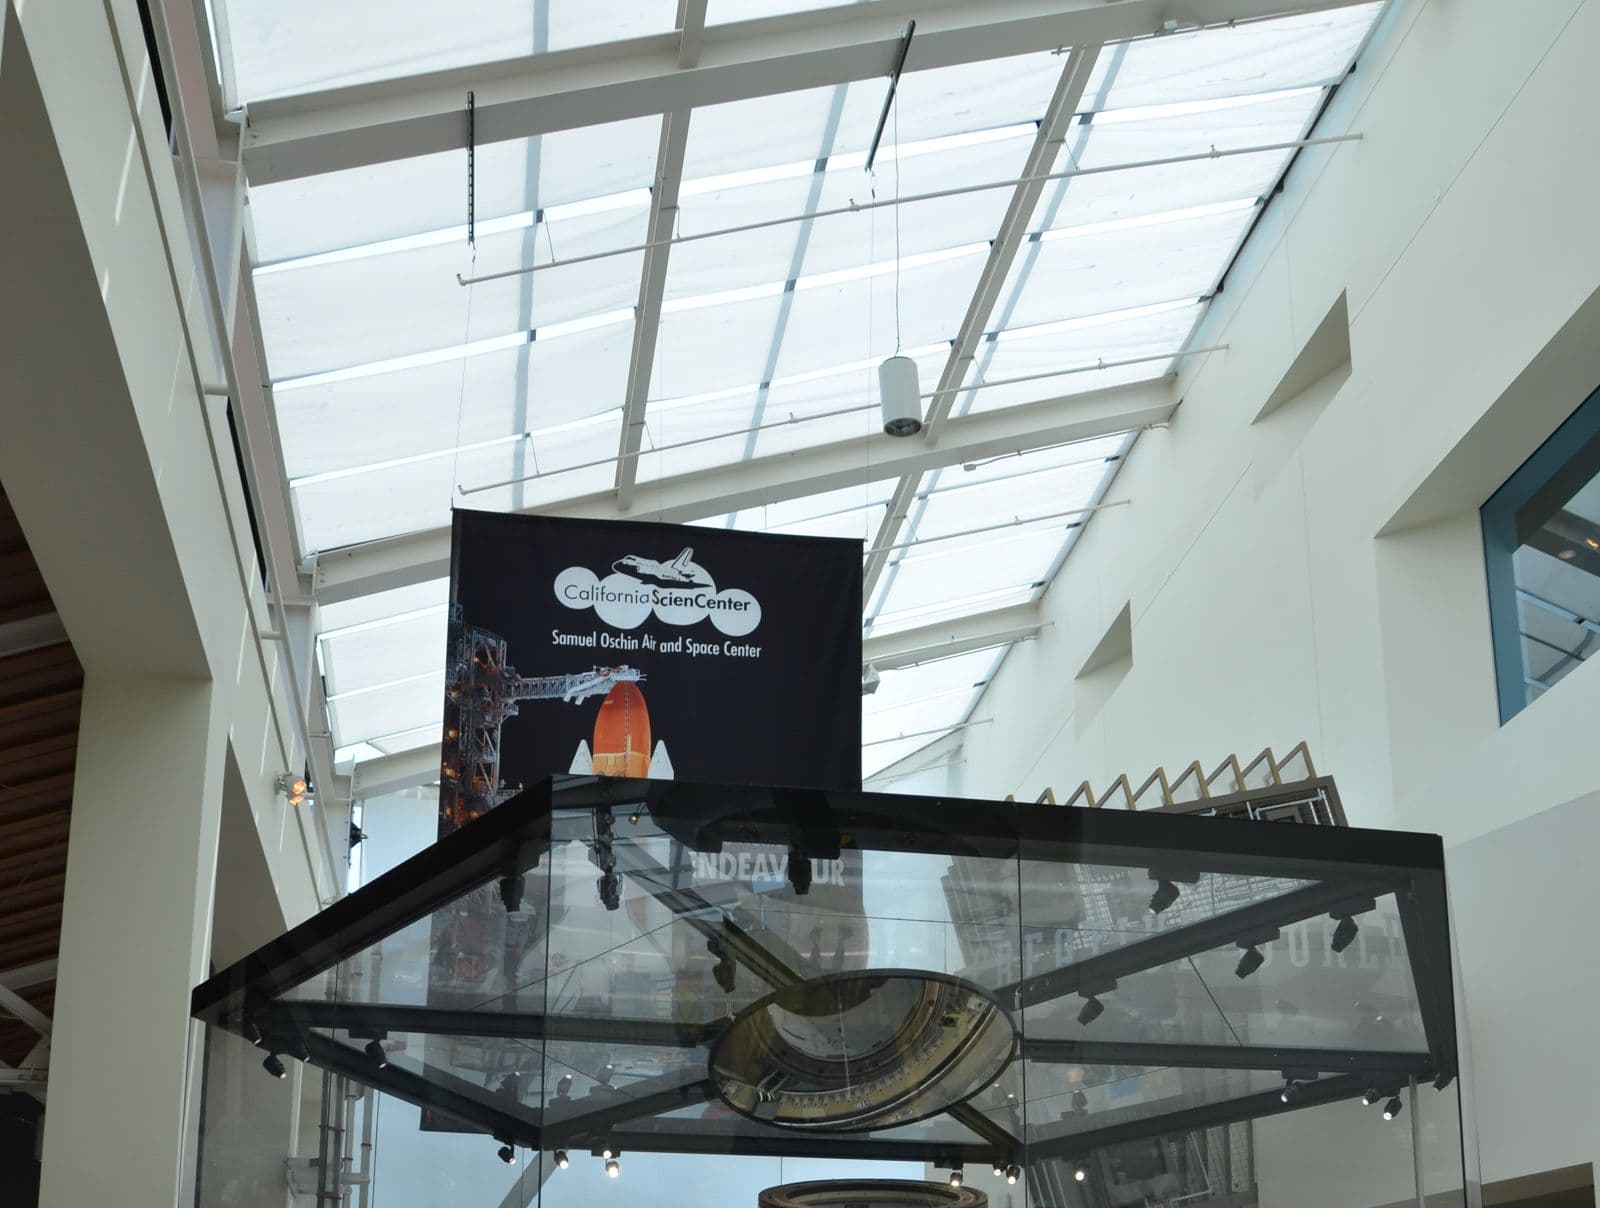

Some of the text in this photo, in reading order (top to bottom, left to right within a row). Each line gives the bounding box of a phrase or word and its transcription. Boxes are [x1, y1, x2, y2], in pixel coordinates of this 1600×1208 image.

[563, 584, 751, 611] California ScienCenter
[552, 629, 762, 658] Samuel Oschin Air and Space Center
[688, 851, 845, 887] ENDEAVUR
